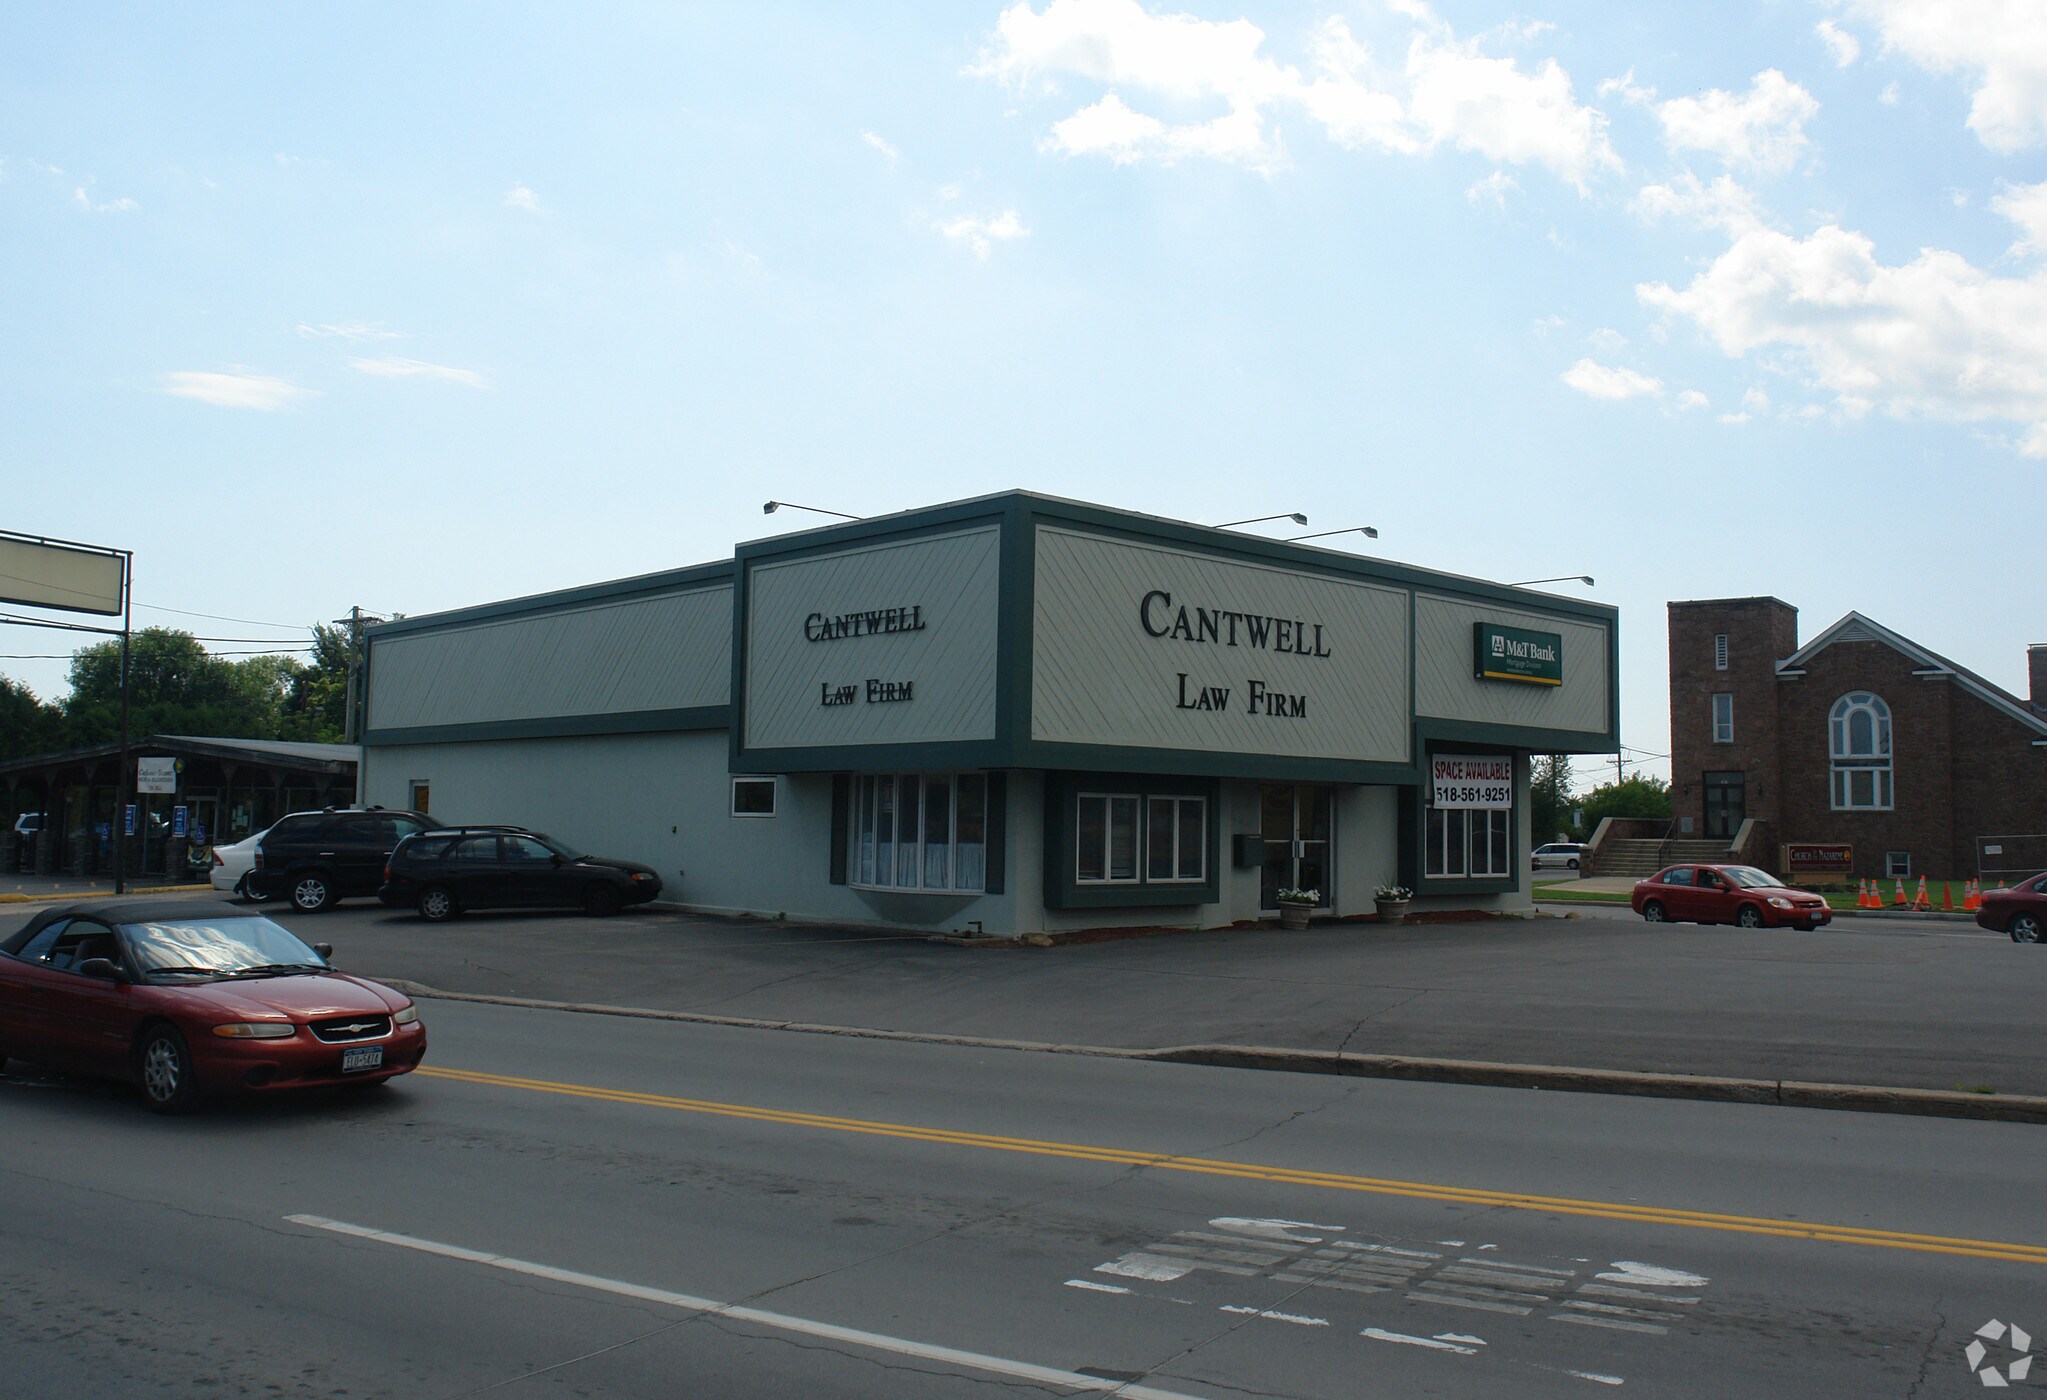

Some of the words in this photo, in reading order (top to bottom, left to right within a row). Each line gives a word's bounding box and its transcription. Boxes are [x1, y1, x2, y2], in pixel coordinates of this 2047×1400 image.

[804, 605, 926, 642] CANTWELL
[1140, 590, 1331, 658] CANTWELL
[1506, 639, 1529, 658] M&T
[1530, 643, 1556, 661] Bank
[821, 682, 858, 706] LAW
[865, 679, 913, 704] FIRM
[1176, 673, 1231, 712] LAW
[1247, 680, 1307, 719] FIRM
[1435, 761, 1463, 780] SPACE
[1465, 762, 1510, 781] AVAILABLE
[1436, 787, 1510, 802] 518-561-9251
